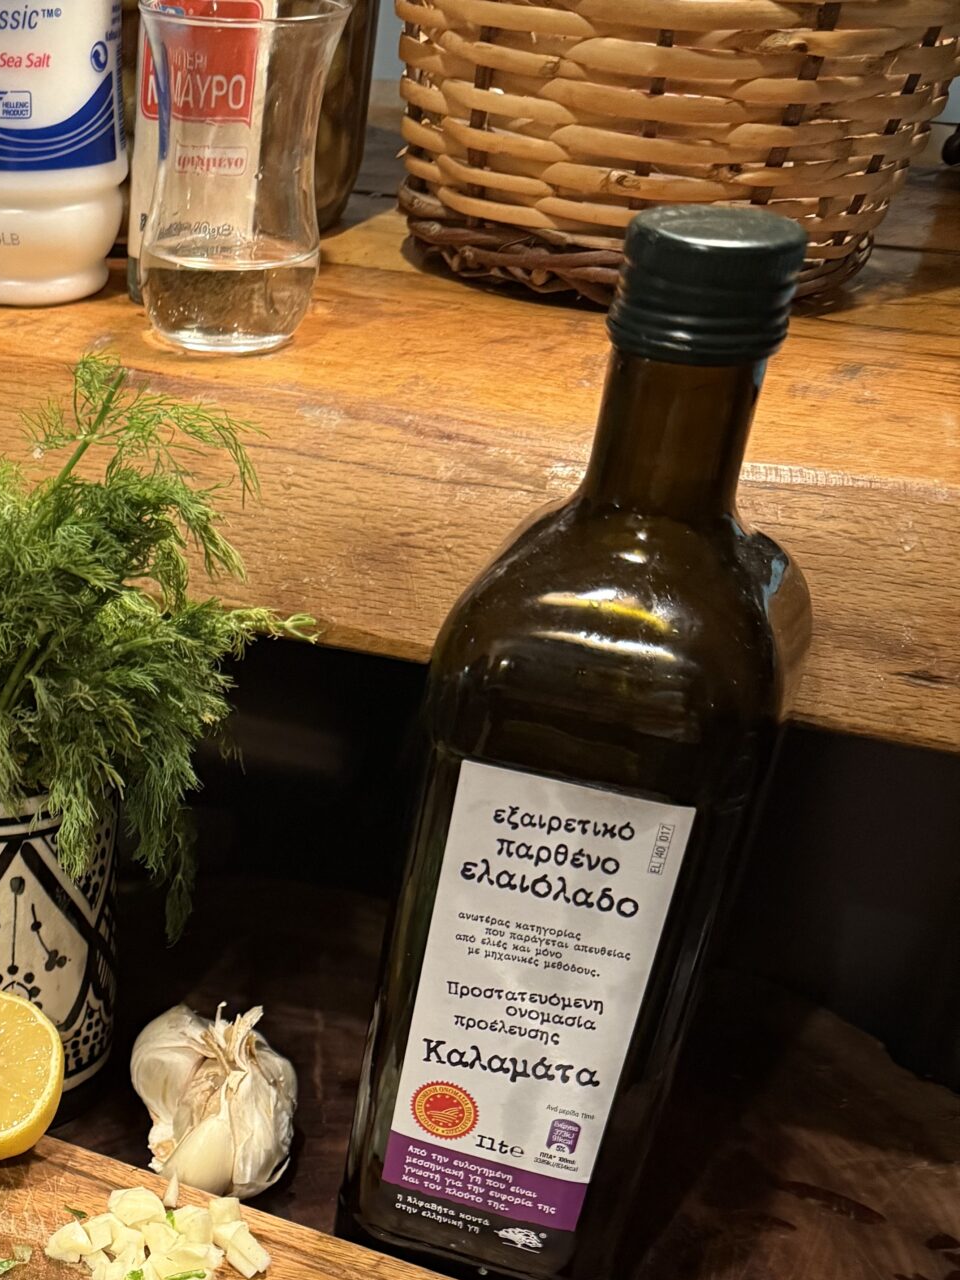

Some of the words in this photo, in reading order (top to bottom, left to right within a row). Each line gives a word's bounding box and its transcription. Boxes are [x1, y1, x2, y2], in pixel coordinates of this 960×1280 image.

[25, 53, 51, 68] Salt
[2, 101, 29, 109] HELLENIC
[493, 805, 635, 841] εξαιρετικό
[659, 825, 672, 842] 017
[496, 838, 620, 875] παρθένο
[655, 846, 666, 859] 40
[650, 863, 662, 874] EL
[460, 858, 639, 918] ελαιόλαδο
[458, 911, 510, 929] ανωτέρας
[515, 921, 581, 941] κατηγορίας
[455, 933, 476, 944] από
[481, 939, 508, 950] ελιές
[513, 943, 531, 953] και
[535, 948, 562, 959] μόνο
[485, 927, 505, 938] που
[509, 931, 569, 950] παράγεται
[574, 944, 631, 961] απευθείας
[468, 946, 480, 955] με
[484, 949, 539, 967] μηχανικές
[543, 960, 600, 978] μεθόδους.
[447, 980, 604, 1015] Προστατευόμενη
[454, 1014, 560, 1045] προέλευσης
[505, 1005, 597, 1031] ονομασία
[423, 1037, 600, 1088] Καλαμάτα
[405, 1156, 464, 1179] μεσσηνιακή
[468, 1174, 482, 1184] γη
[485, 1179, 506, 1190] που
[510, 1185, 537, 1198] είναι
[407, 1145, 427, 1157] Από
[431, 1153, 449, 1164] την
[453, 1160, 513, 1183] ευλογημένη
[402, 1174, 420, 1185] και
[423, 1181, 442, 1191] τον
[445, 1187, 483, 1203] πλούτο
[404, 1165, 441, 1182] γνωστή
[445, 1177, 463, 1187] για
[467, 1183, 485, 1194] την
[489, 1190, 533, 1207] ευφορία
[537, 1202, 556, 1214] της
[395, 1202, 418, 1214] στην
[421, 1210, 463, 1229] ελληνική
[467, 1224, 480, 1234] γη
[459, 1212, 490, 1226] κοντά
